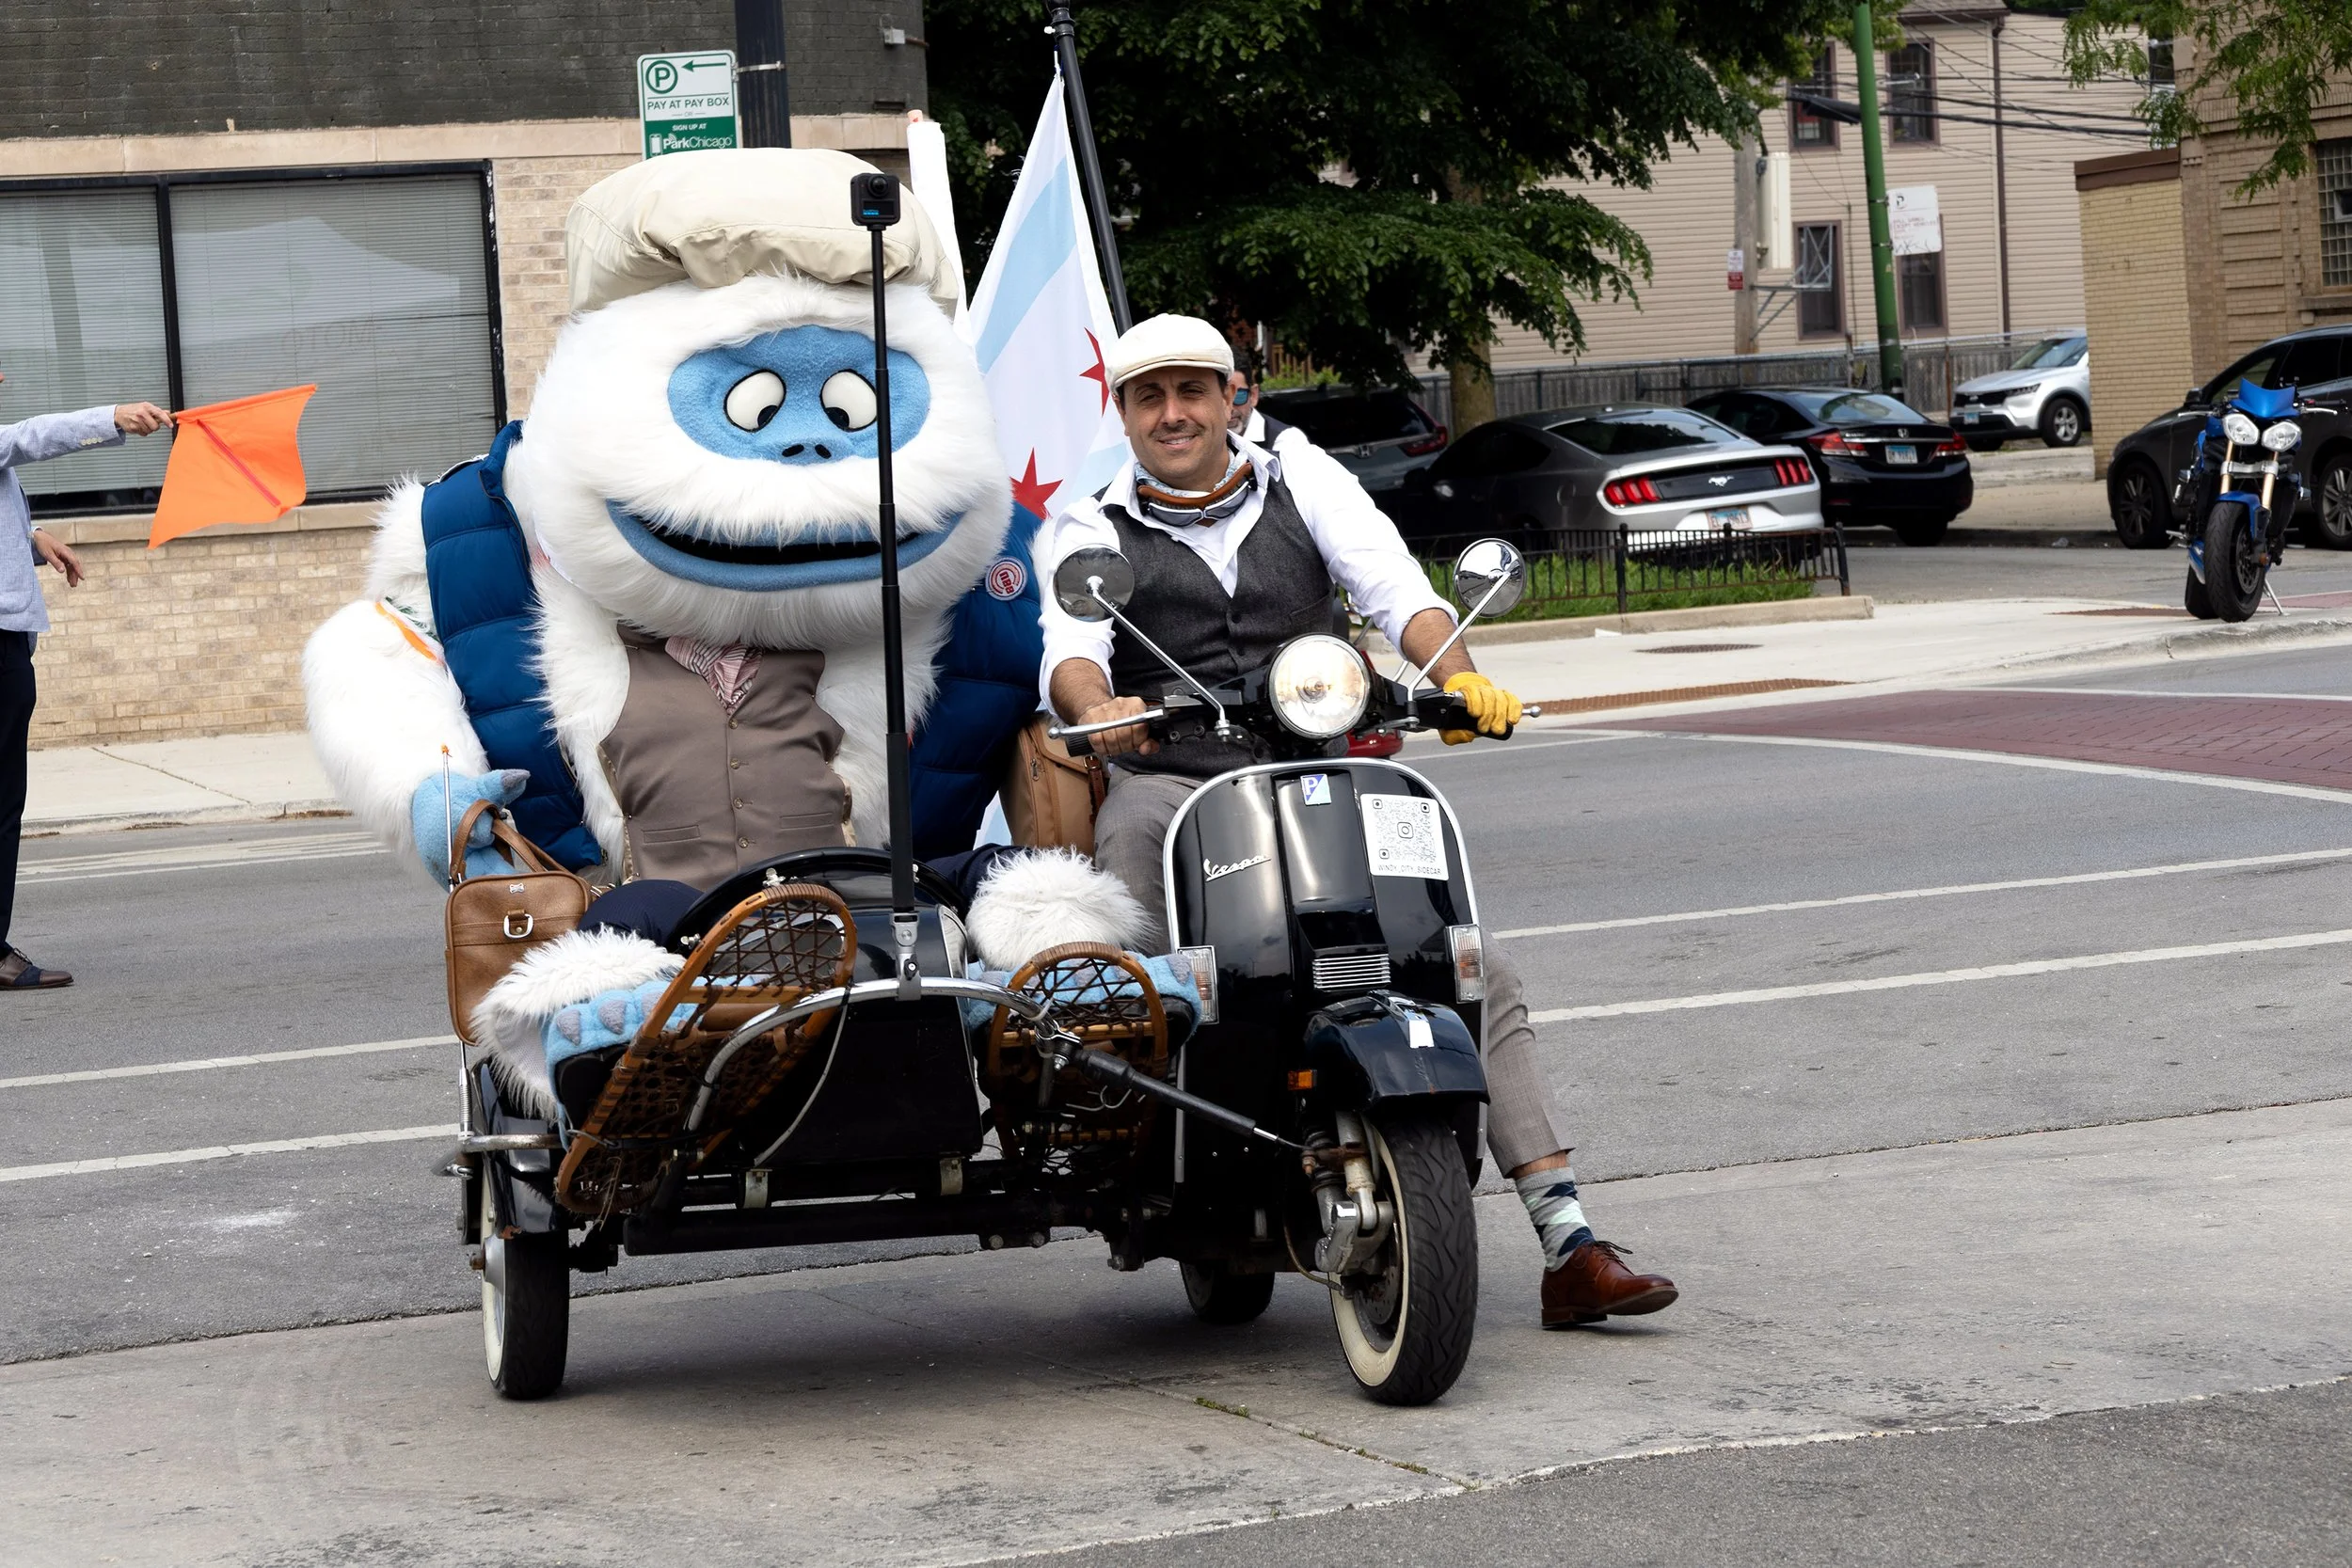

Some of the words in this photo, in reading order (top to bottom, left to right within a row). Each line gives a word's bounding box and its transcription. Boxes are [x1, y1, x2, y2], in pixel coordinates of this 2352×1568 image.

[654, 67, 671, 88] P
[647, 100, 667, 110] PAY
[669, 99, 681, 108] AT
[685, 99, 704, 108] PAY
[707, 97, 729, 107] BOX
[663, 135, 732, 149] ParkChicago
[1303, 777, 1319, 796] P
[1203, 856, 1272, 881] Vespa
